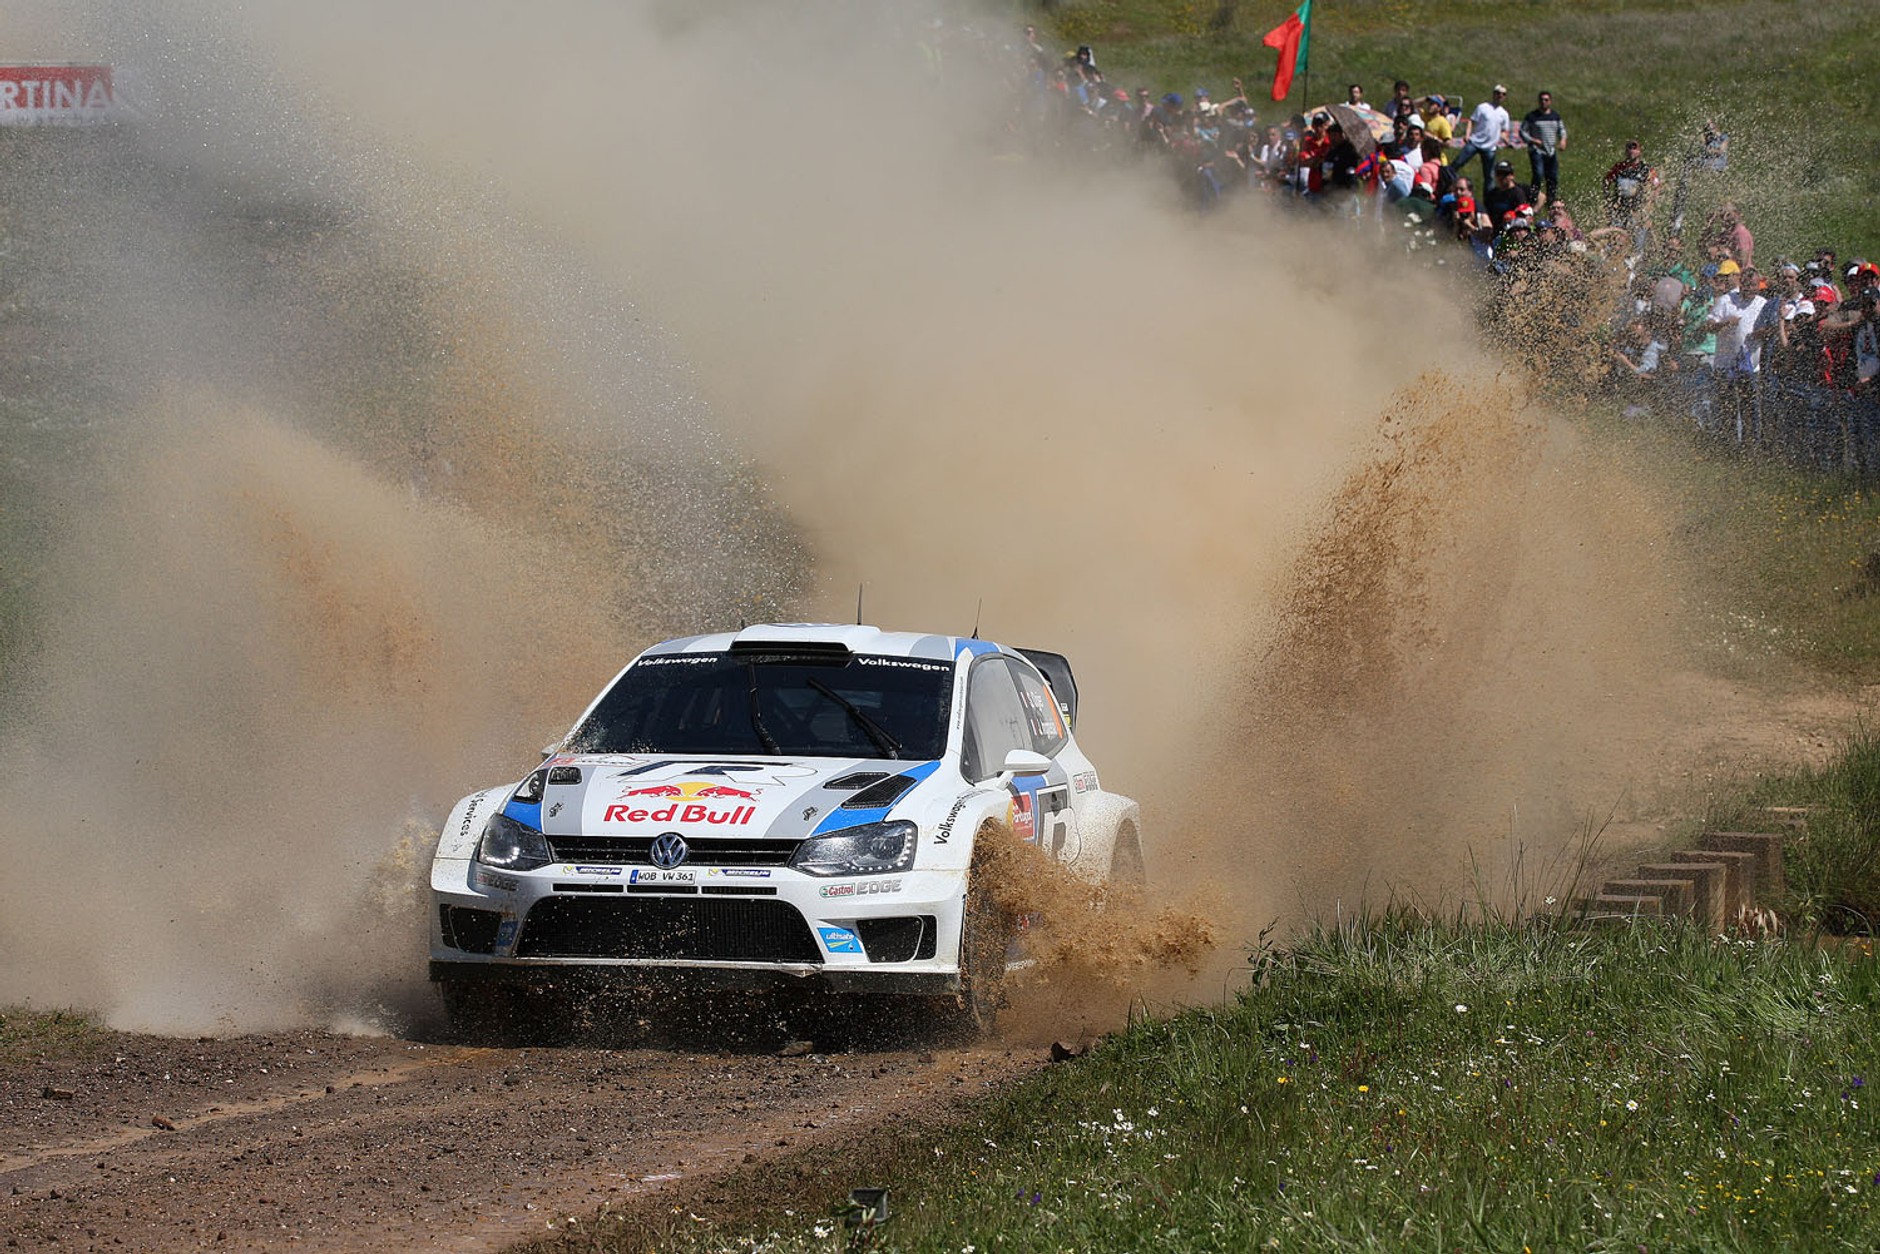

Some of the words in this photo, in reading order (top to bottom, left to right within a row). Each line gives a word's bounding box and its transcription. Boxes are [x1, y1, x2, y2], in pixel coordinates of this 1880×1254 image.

[637, 655, 719, 667] Volkswagen
[858, 657, 950, 672] Volkswagen
[603, 803, 679, 823] Red
[680, 804, 756, 826] Bull
[637, 872, 657, 881] WOB
[828, 885, 854, 896] Castrol
[856, 879, 903, 895] EDGE
